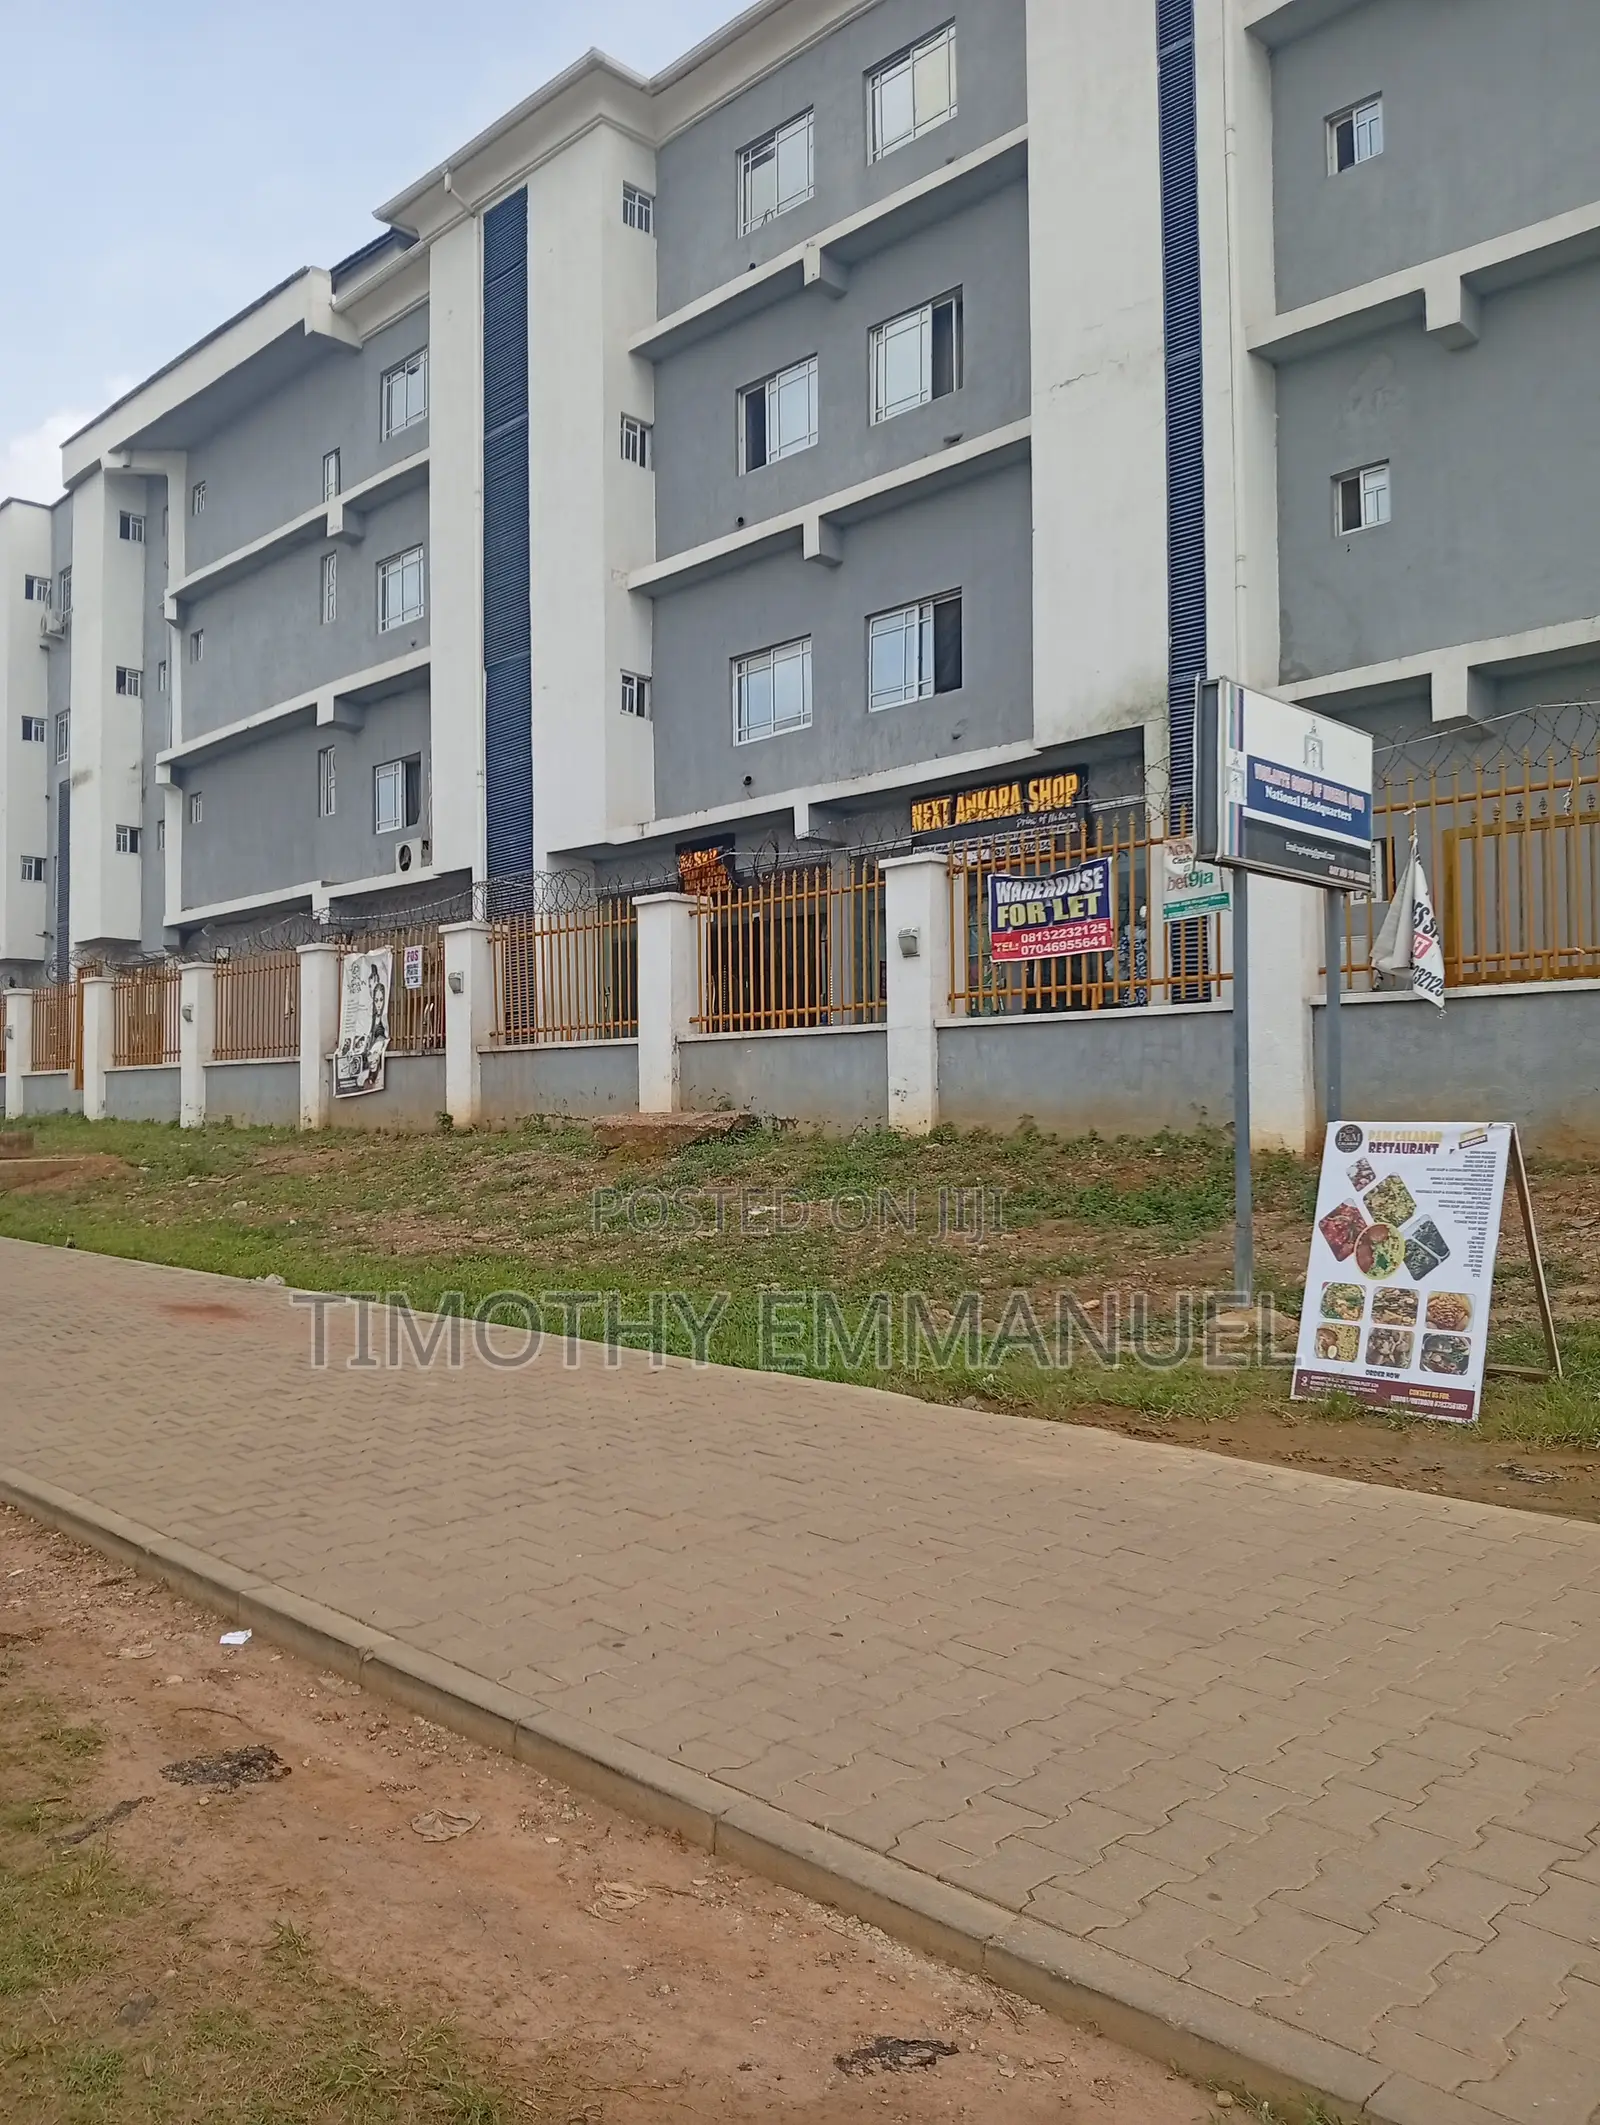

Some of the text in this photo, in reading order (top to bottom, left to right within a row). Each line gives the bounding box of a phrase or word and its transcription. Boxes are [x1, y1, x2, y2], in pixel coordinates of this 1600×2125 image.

[911, 797, 951, 832] NEXT
[955, 783, 1021, 824] ANKARA
[1028, 773, 1078, 813] SHOP
[1265, 785, 1352, 821] National Headquarters
[996, 866, 1104, 904] WAREHOUSE
[997, 891, 1101, 928] FOR LET
[994, 936, 1106, 955] TEL: 07046955641
[1021, 923, 1107, 943] 08132232125
[1368, 1142, 1439, 1154] RESTAURANT
